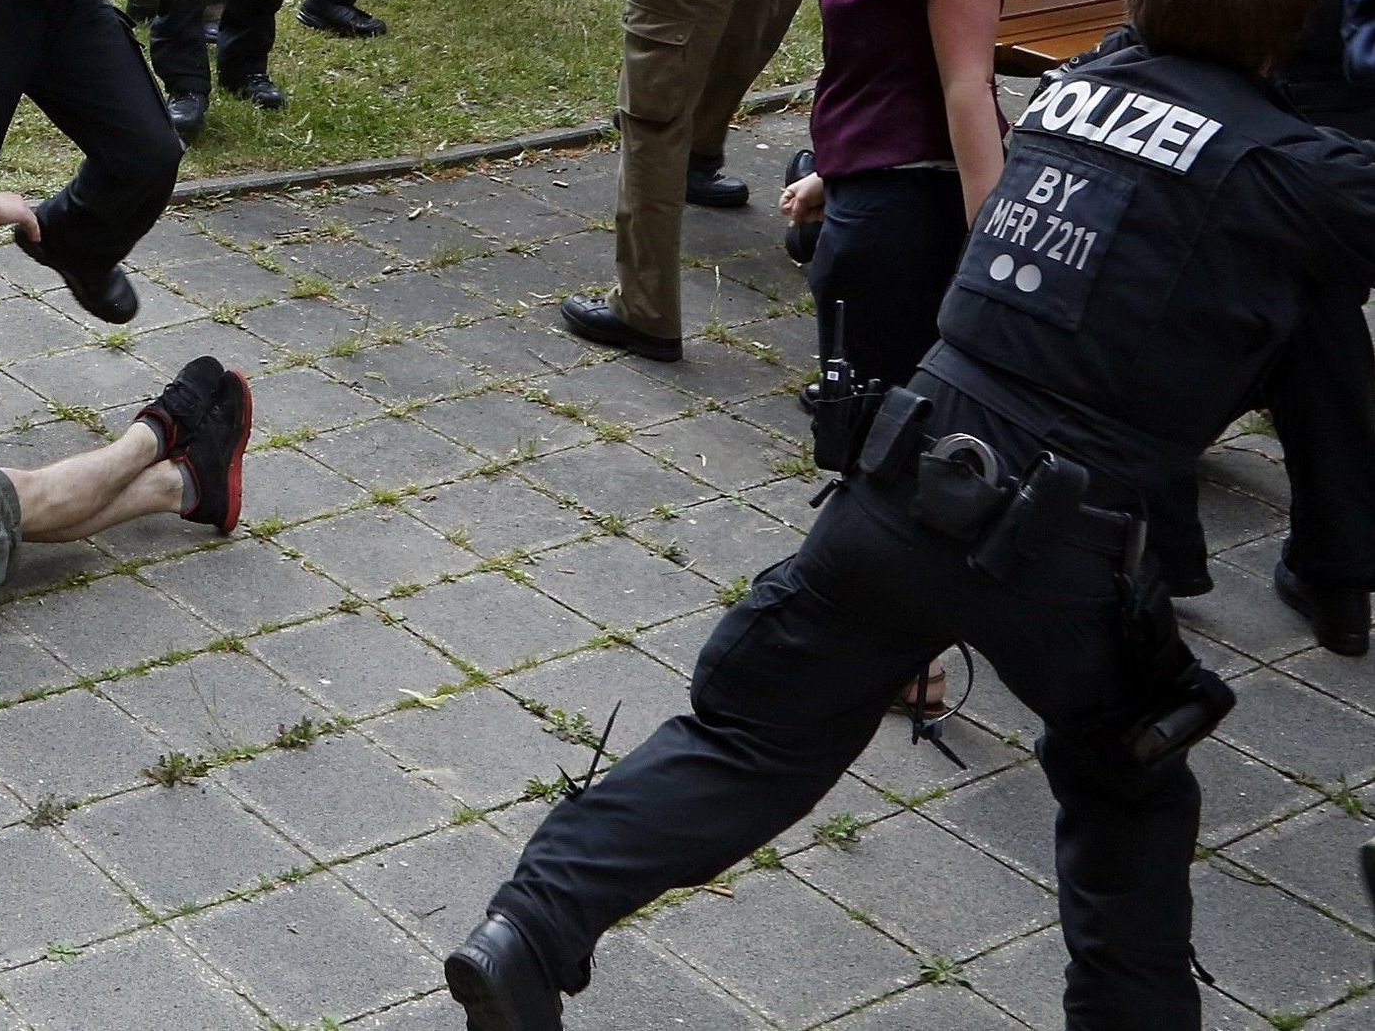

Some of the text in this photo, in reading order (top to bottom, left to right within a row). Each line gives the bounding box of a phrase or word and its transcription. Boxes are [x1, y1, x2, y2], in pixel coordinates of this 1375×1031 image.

[1014, 80, 1224, 173] POLIZEI
[1025, 166, 1090, 213] BY
[983, 198, 1098, 271] MFR 7211
